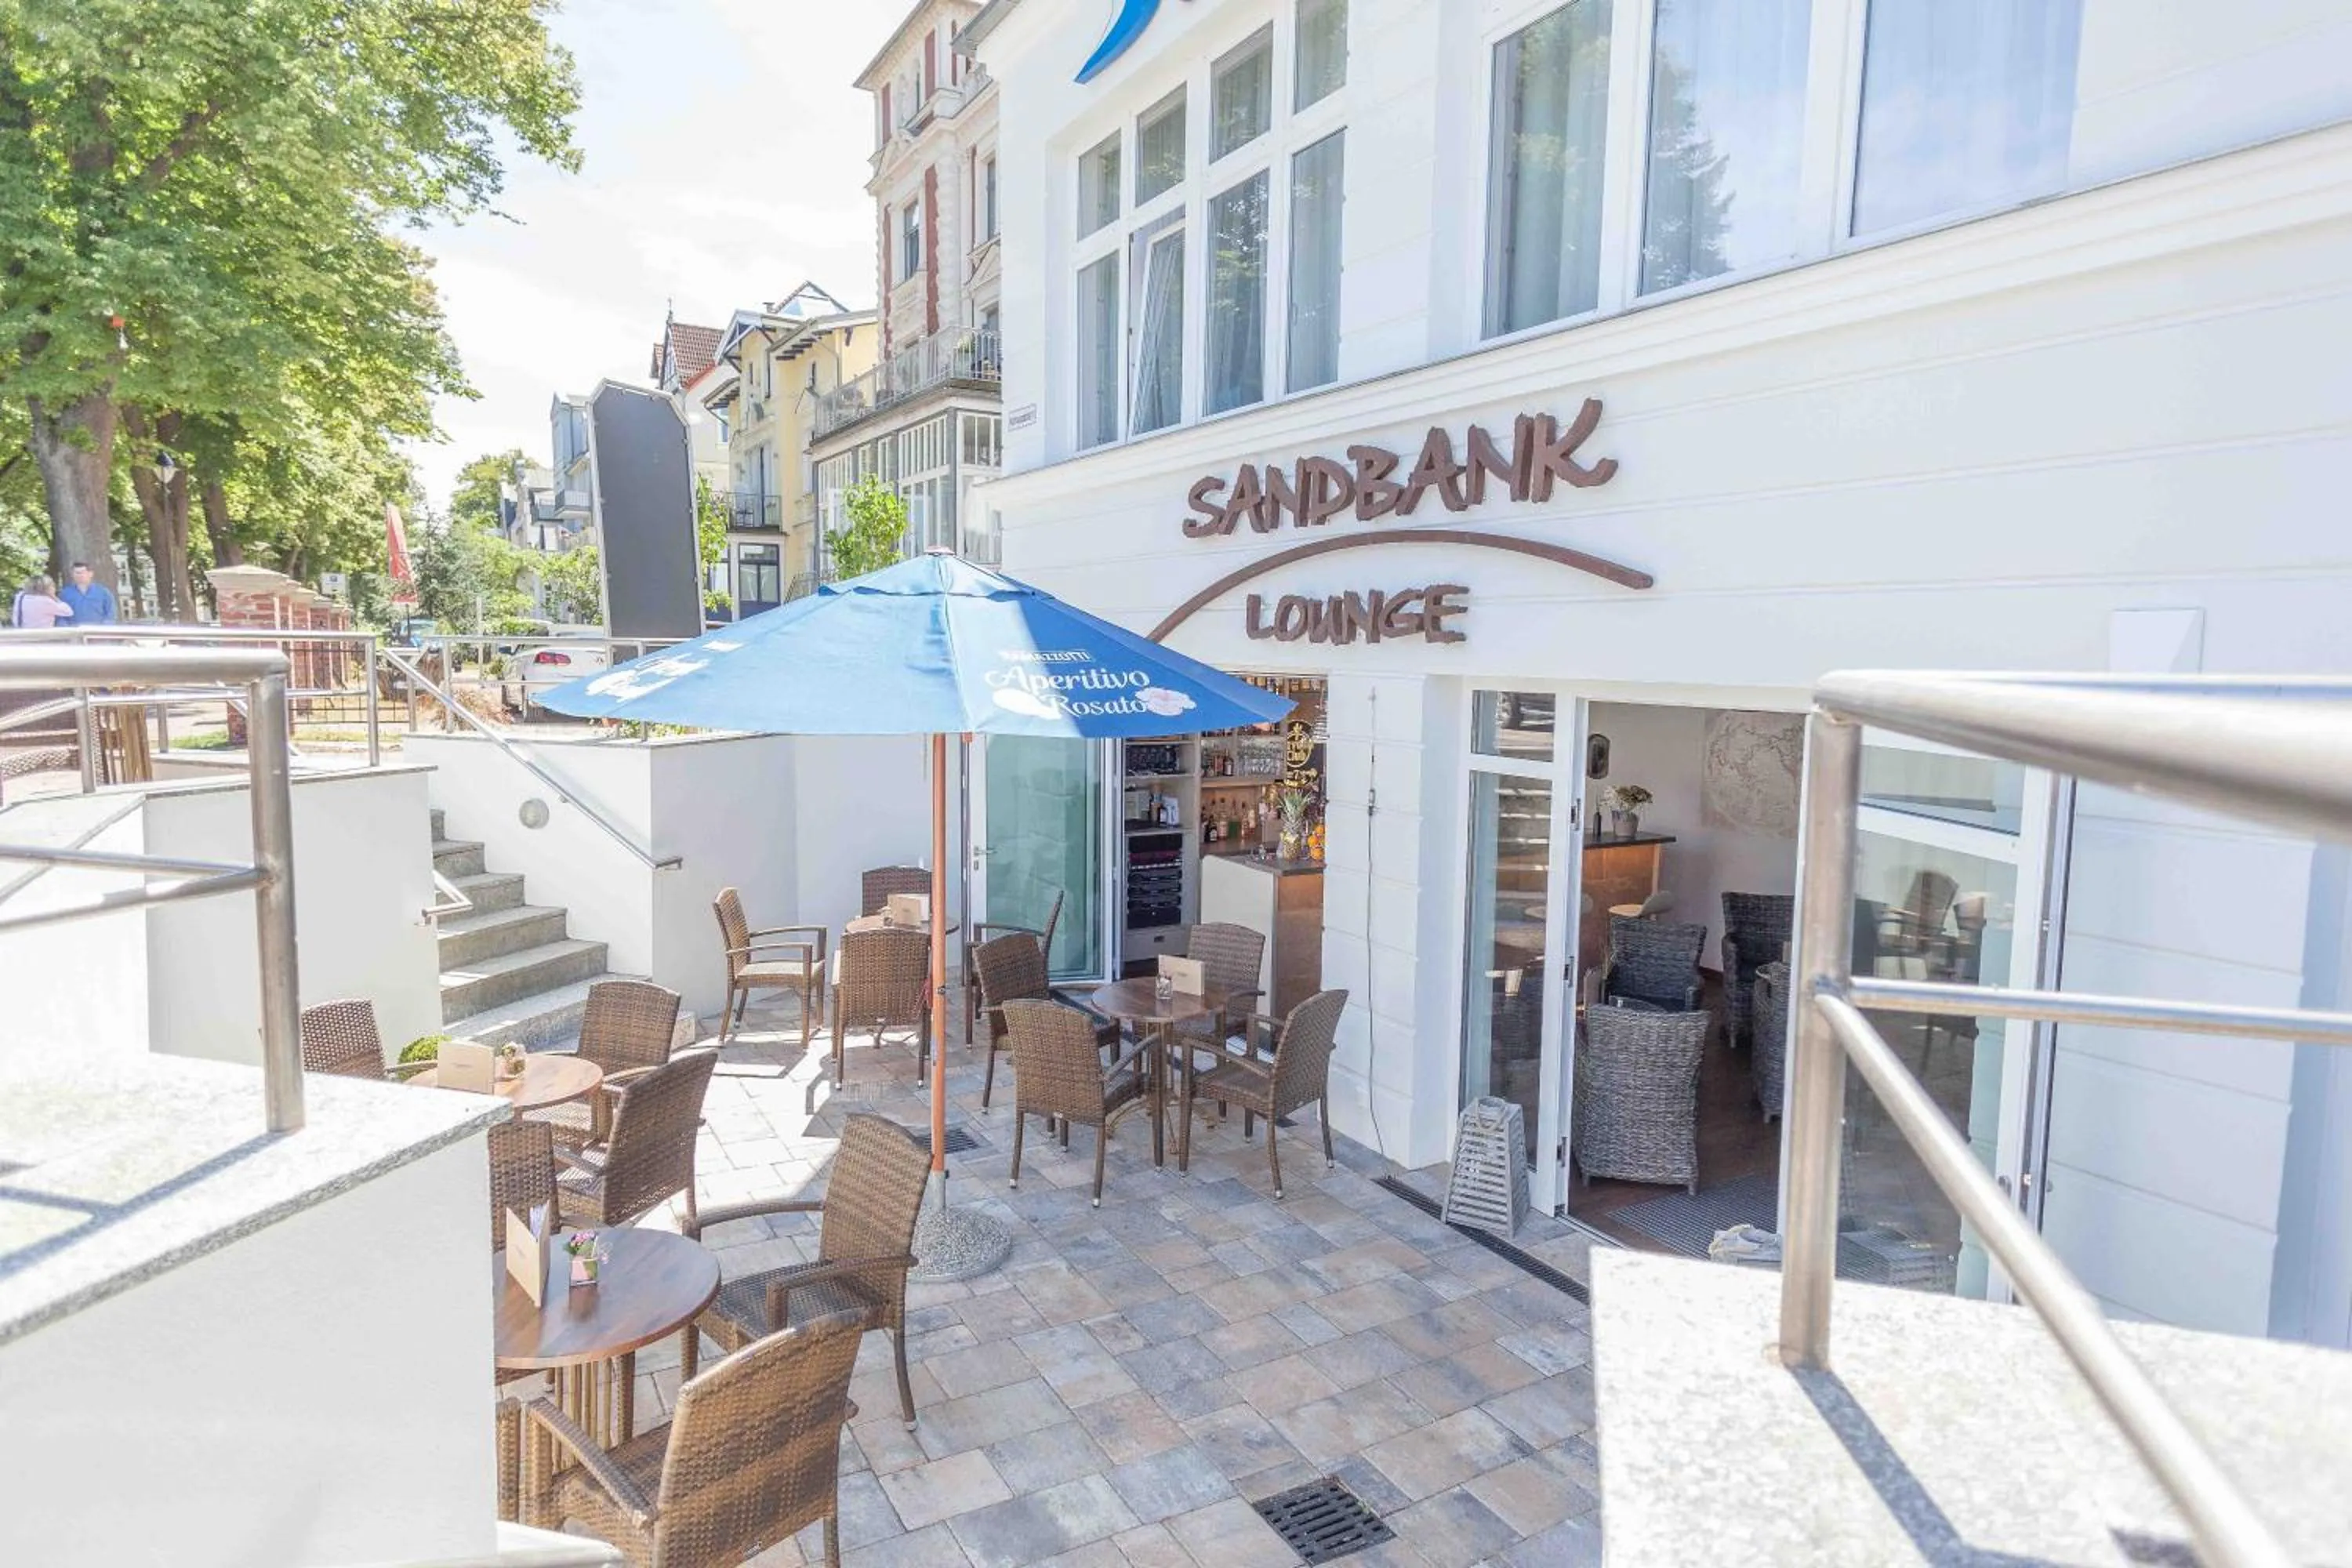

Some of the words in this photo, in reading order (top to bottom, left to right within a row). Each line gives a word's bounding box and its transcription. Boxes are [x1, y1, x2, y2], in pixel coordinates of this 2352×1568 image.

[1182, 397, 1618, 538] SANDBANK
[1246, 583, 1470, 645] LOUNGE
[985, 665, 1151, 695] Aperitivo
[1037, 694, 1147, 717] Rosato
